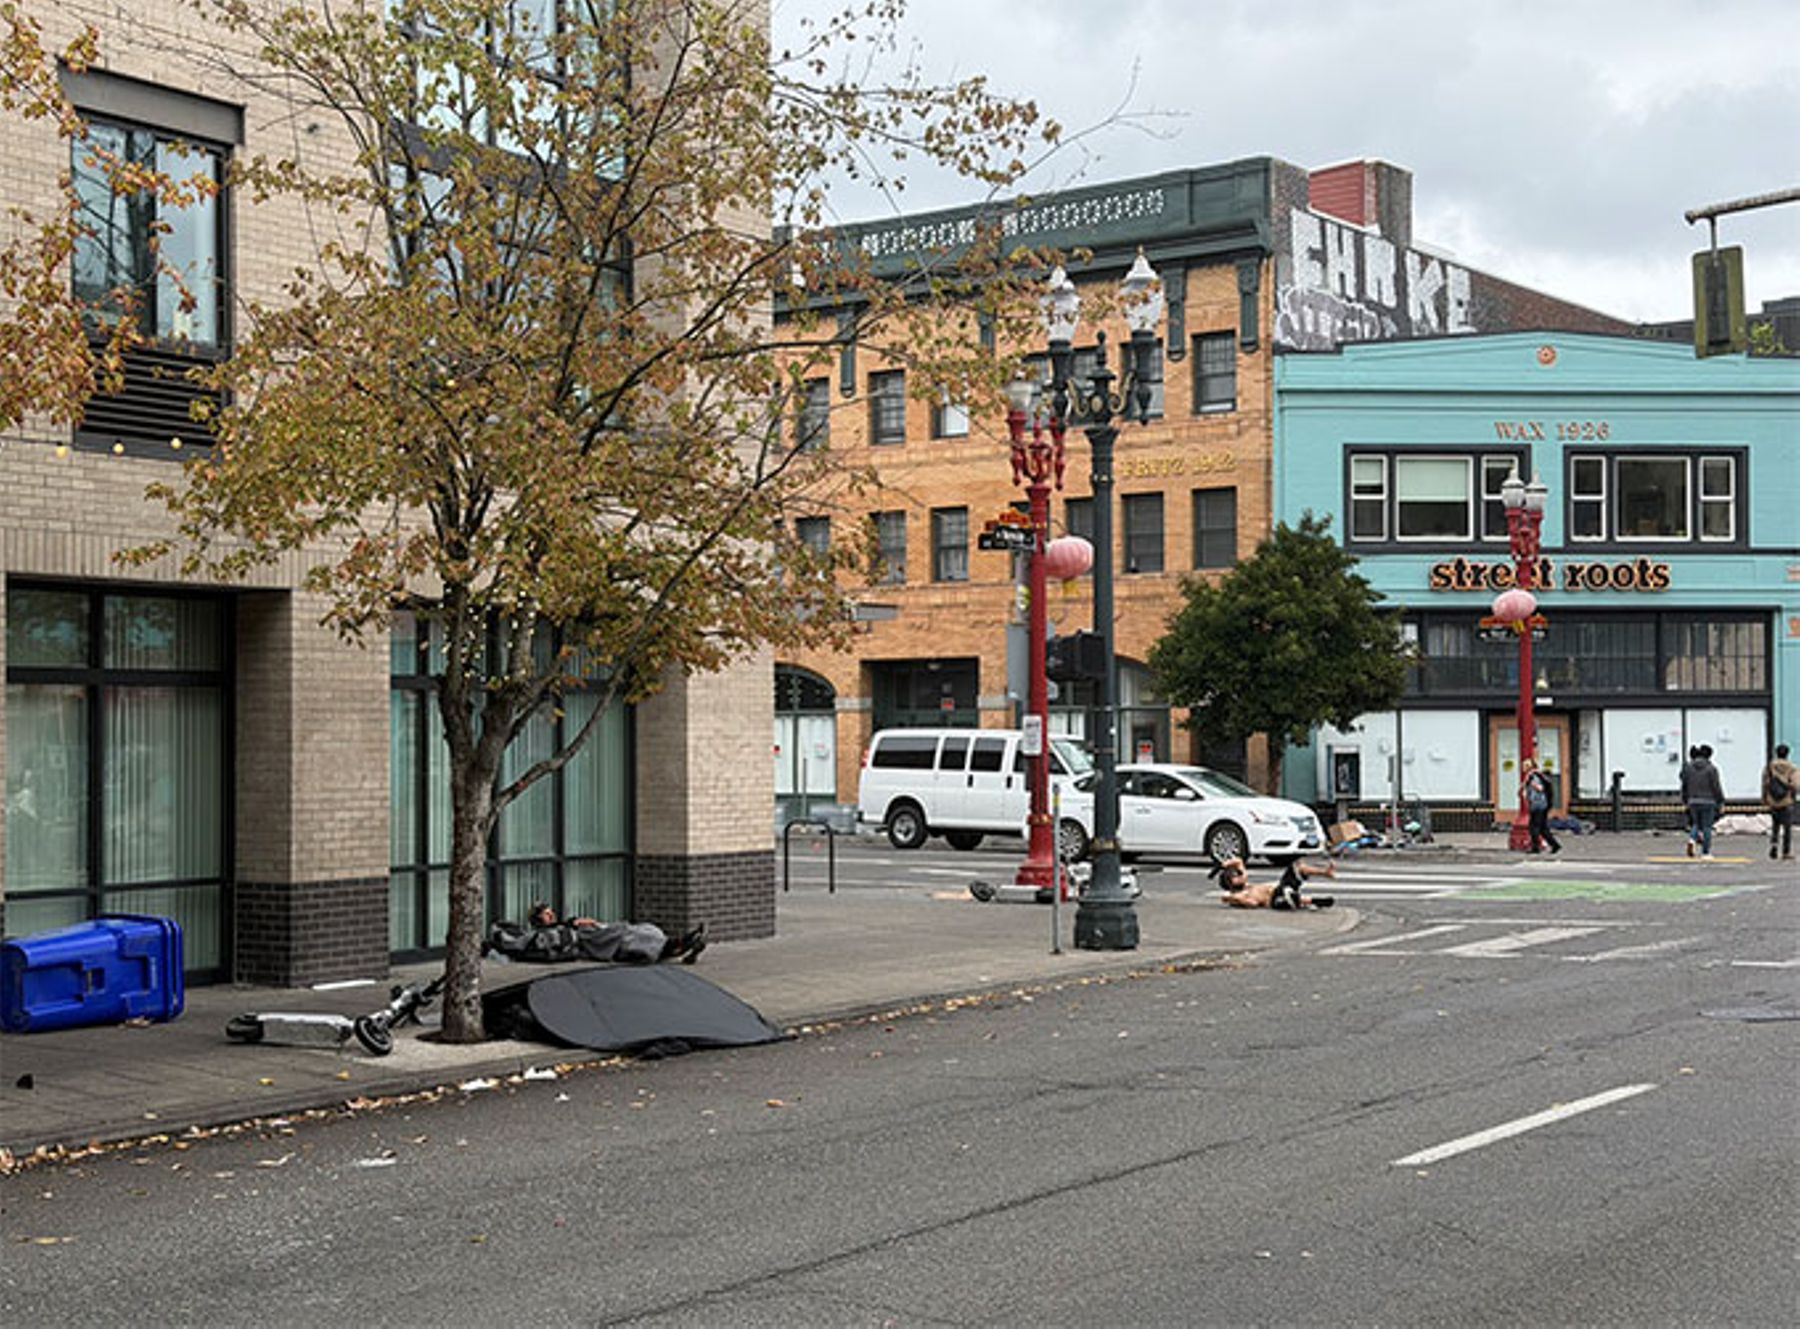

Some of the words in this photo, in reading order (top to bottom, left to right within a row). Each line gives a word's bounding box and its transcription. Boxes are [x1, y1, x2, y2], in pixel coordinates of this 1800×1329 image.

[1493, 420, 1546, 441] WAX
[1556, 420, 1610, 441] 1926
[1564, 555, 1672, 590] roots
